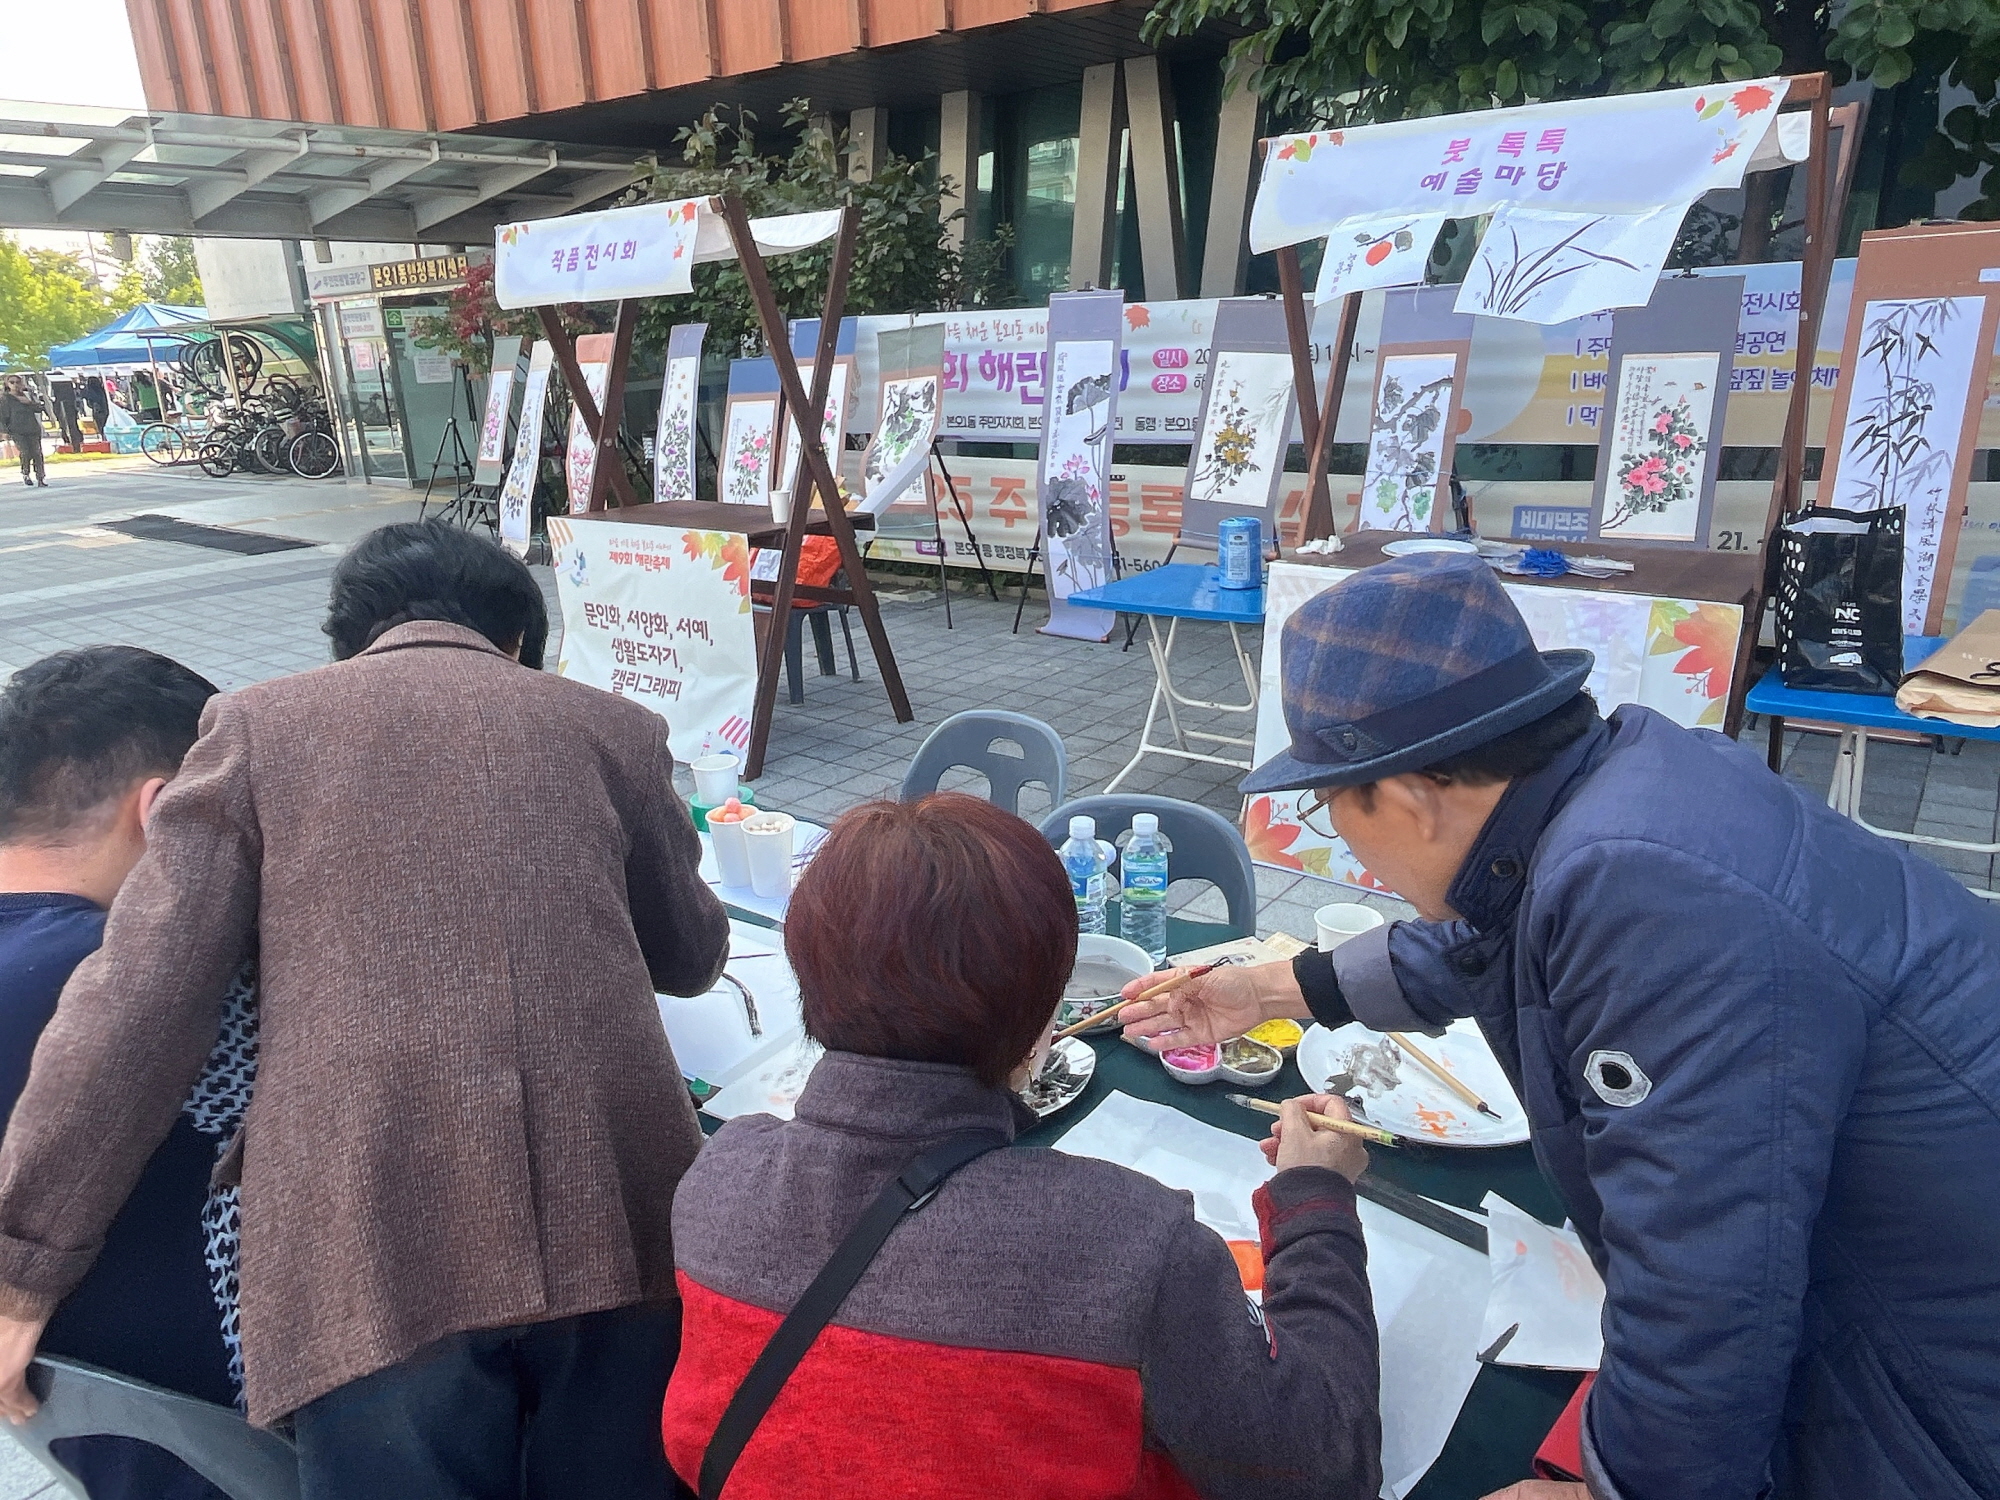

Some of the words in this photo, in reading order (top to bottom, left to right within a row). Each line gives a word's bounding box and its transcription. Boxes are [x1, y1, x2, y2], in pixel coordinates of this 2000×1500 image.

[1441, 138, 1472, 165] 붓
[1497, 128, 1567, 158] 톡톡
[1420, 161, 1569, 196] 예술마당
[550, 238, 639, 275] 작품전시회
[966, 321, 989, 342] 채운
[1157, 350, 1182, 368] 일시
[1195, 348, 1211, 365] 20
[944, 349, 969, 393] 회
[979, 349, 1047, 404] 해란
[1157, 375, 1181, 393] 장소
[978, 415, 1026, 430] 주민자치회,
[1028, 416, 1043, 430] 본오
[1580, 406, 1603, 427] 먹
[1520, 510, 1589, 532] 비대면조
[955, 541, 993, 558] 본오동
[1717, 530, 1748, 551] 21.
[609, 551, 633, 565] 제9회
[634, 552, 671, 573] 해란축제
[583, 601, 625, 632] 문인화,
[626, 609, 674, 640] 서양화,
[676, 616, 714, 647] 서예,
[1834, 607, 1861, 621] NC
[611, 636, 684, 673] 생활도자기,
[610, 668, 683, 702] 캘리그래피
